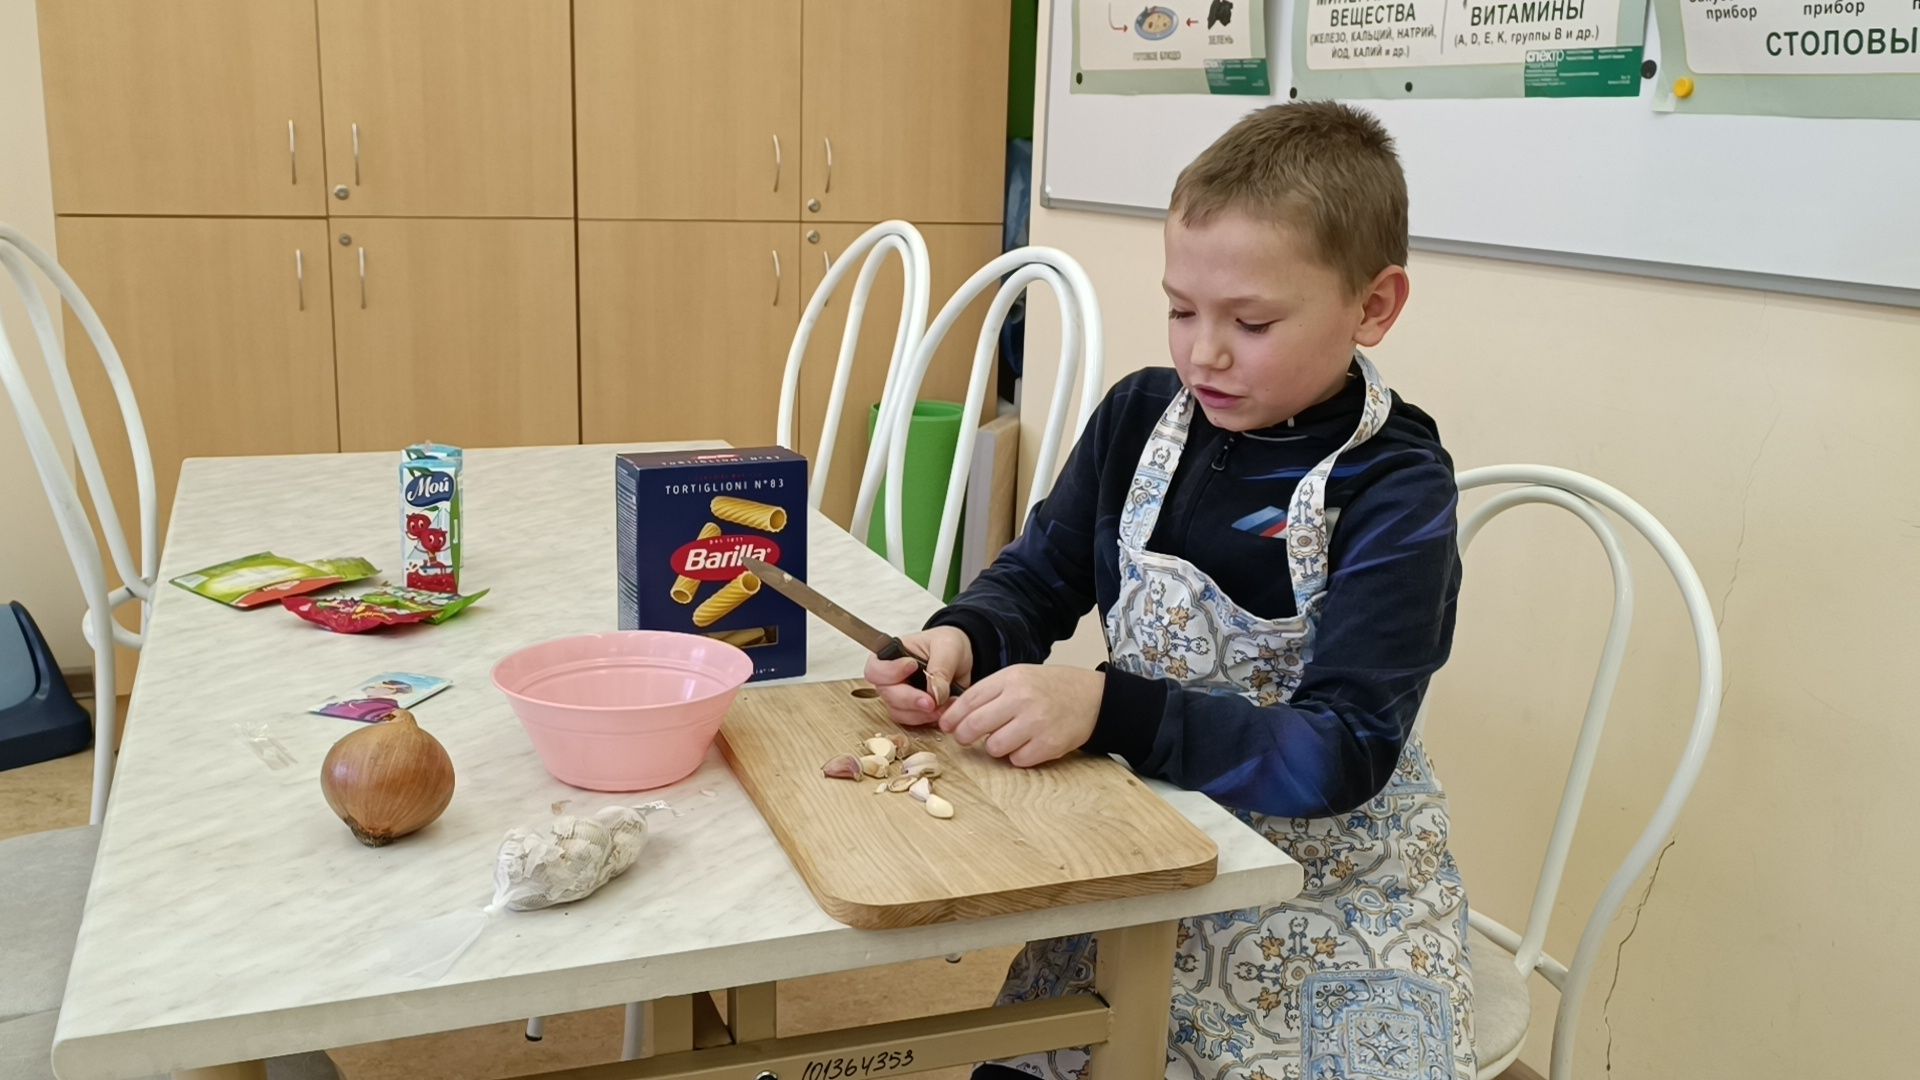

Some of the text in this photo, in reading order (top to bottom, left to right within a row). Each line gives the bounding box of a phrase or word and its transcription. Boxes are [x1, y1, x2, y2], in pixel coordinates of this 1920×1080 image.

[1330, 3, 1416, 28] ВЕЩЕСТВА
[1470, 0, 1585, 26] ВИТАМИНЫ
[1706, 4, 1757, 22] прибор
[1803, 0, 1865, 18] прибор
[1397, 24, 1437, 39] НАТРИЙ,
[1511, 31, 1550, 45] группы
[1566, 29, 1573, 39] и
[1576, 24, 1599, 41] др.)
[1766, 26, 1919, 56] СТОЛОВЫ
[407, 476, 450, 501] Мой
[665, 480, 747, 495] TORTIGLIONI
